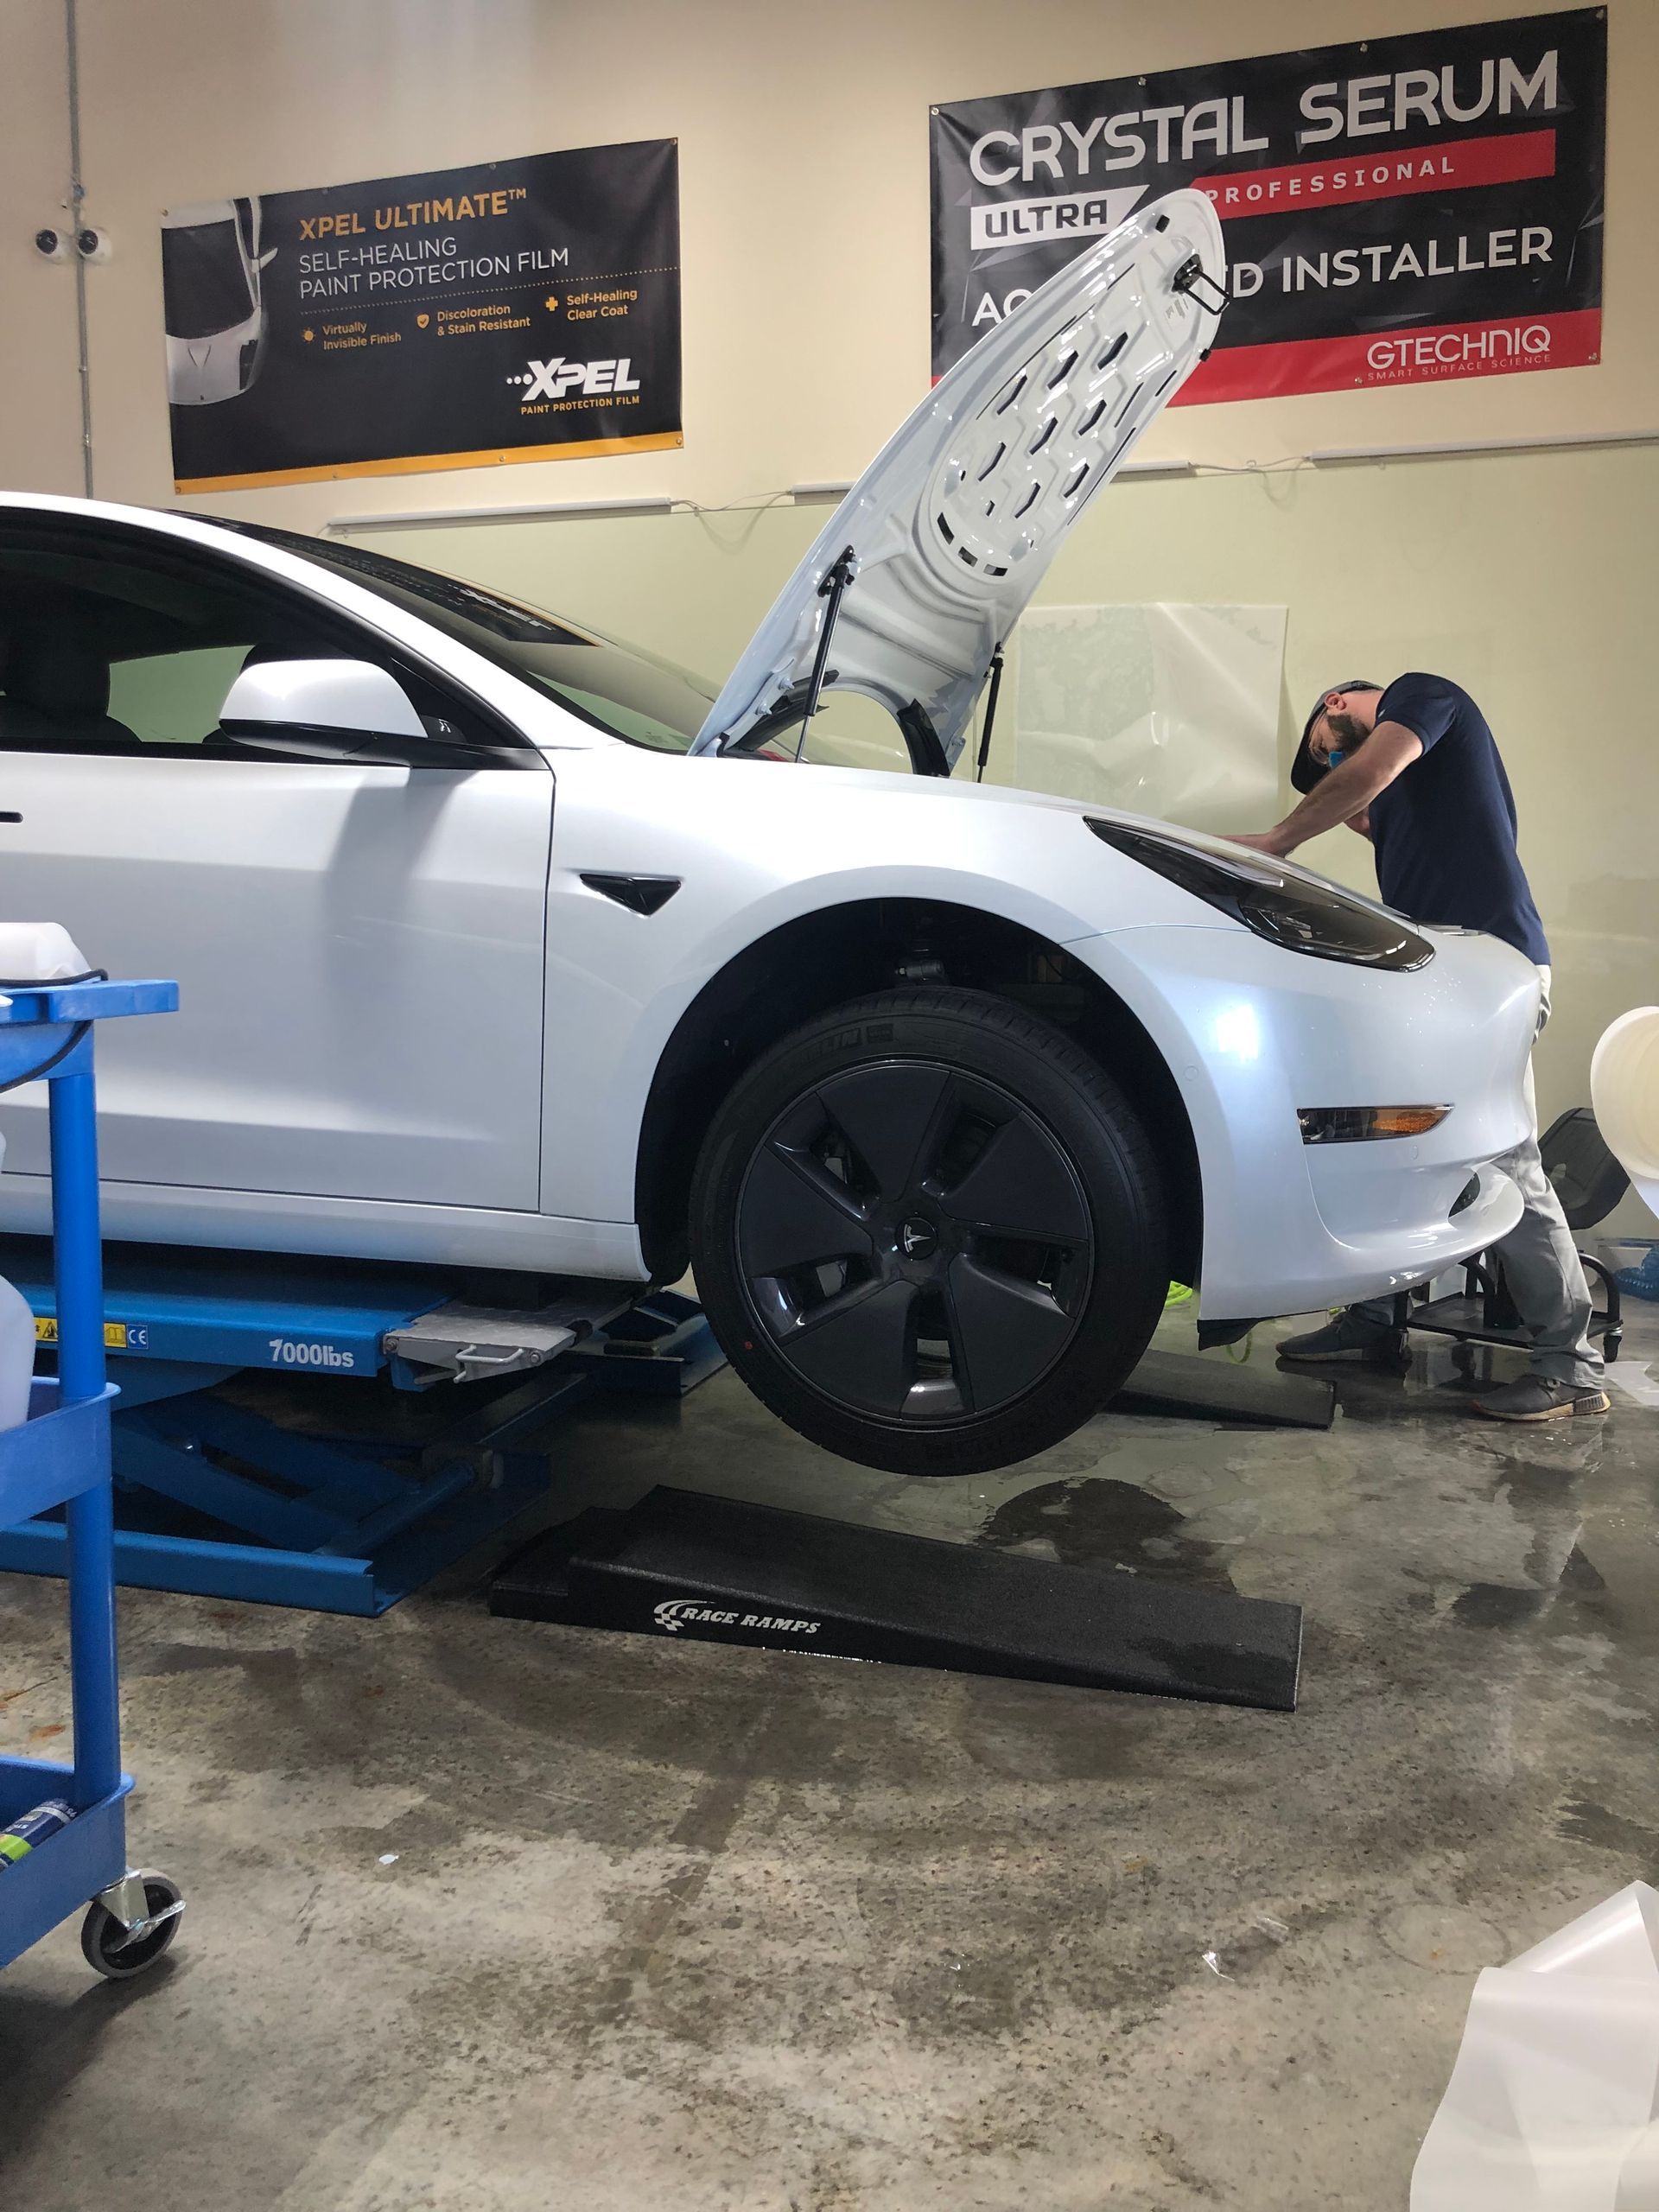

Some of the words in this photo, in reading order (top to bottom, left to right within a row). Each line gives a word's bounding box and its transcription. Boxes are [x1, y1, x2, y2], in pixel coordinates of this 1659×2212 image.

[969, 96, 1269, 187] CRYSTAL
[1300, 49, 1558, 143] SERUM
[1205, 156, 1454, 204] PROFESSIONAL
[299, 213, 366, 241] XPEL
[985, 199, 1108, 238] ULTRA
[299, 237, 457, 274] SELF-HEALING
[1282, 226, 1554, 294] INSTALLER
[300, 274, 361, 299] PAINT
[369, 255, 510, 290] PROTECTION
[518, 247, 569, 272] FILM
[567, 289, 638, 306] Self-Healing
[437, 304, 511, 321] Discoloration
[437, 326, 445, 336] &
[448, 321, 475, 335] Stain
[480, 316, 531, 332] Resistant
[567, 308, 597, 321] Clear
[601, 304, 628, 317] Coat
[322, 321, 367, 336] Virtually
[323, 335, 367, 350] Invisible
[370, 332, 402, 346] Finish
[1367, 325, 1551, 370] GTECHNIQ
[522, 357, 641, 401] XPEL
[1368, 368, 1413, 381] SMART
[1421, 361, 1483, 375] SURFACE
[1491, 354, 1551, 368] SCIENCE
[521, 404, 550, 415] PAINT
[553, 397, 613, 412] PROTECTION
[616, 395, 640, 405] FILM
[128, 1329, 147, 1344] CE
[270, 1339, 354, 1368] 7000lbs
[680, 1607, 739, 1624] RACE
[740, 1614, 821, 1634] RAMPS
